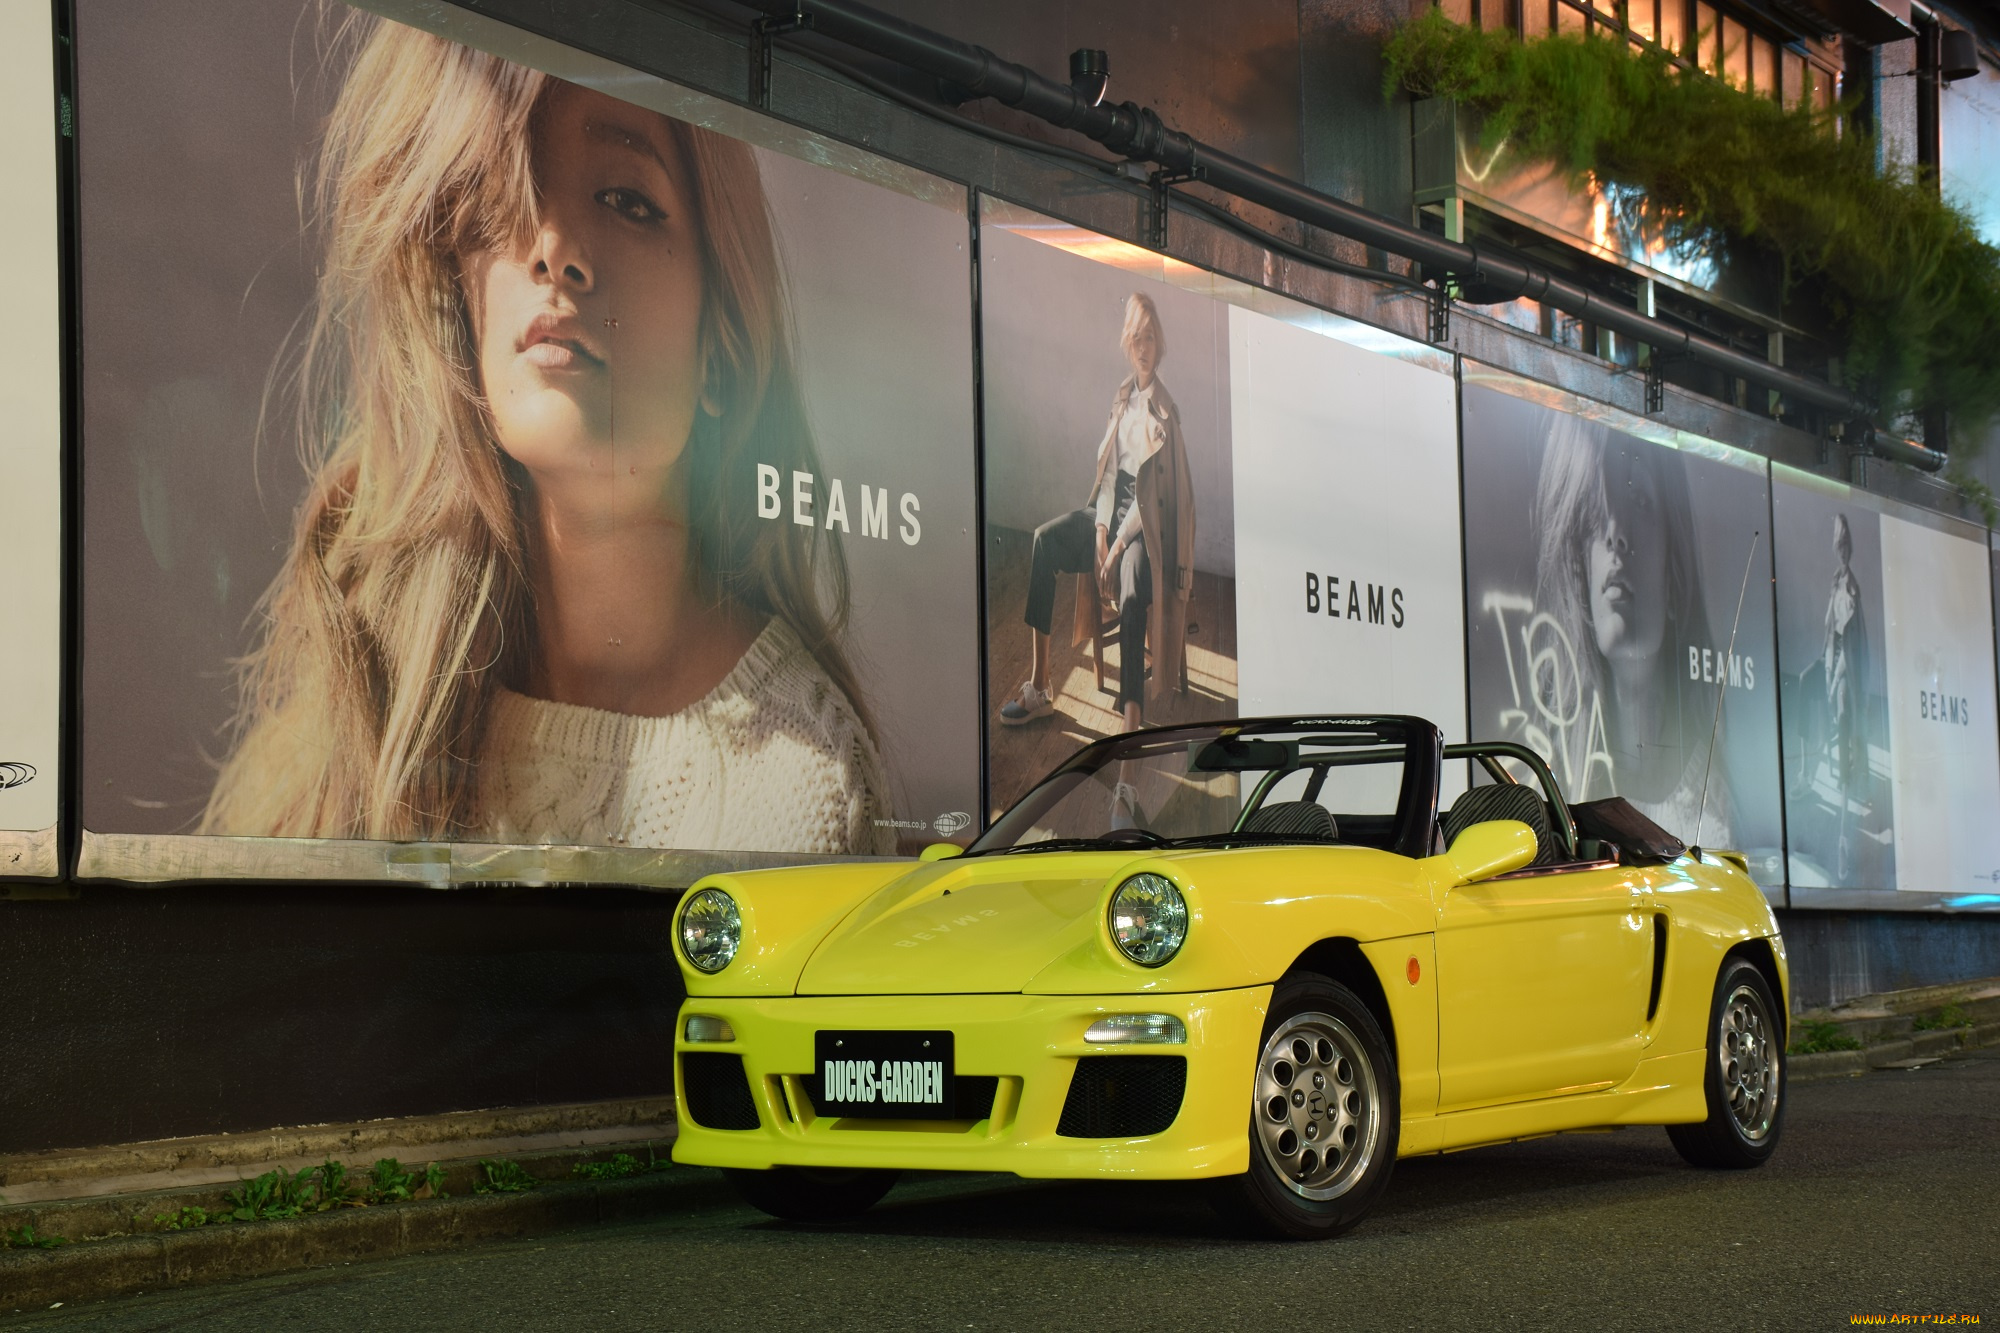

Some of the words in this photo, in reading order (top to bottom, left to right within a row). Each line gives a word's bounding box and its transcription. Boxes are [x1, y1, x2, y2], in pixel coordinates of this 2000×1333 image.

[757, 463, 921, 546] BEAMS
[1306, 571, 1404, 629] BEAMS
[1688, 645, 1755, 691] BEAMS
[1920, 690, 1969, 727] BEAMS
[873, 817, 927, 831] www.beams.co.jp
[824, 1059, 943, 1104] DUCKS-GARDEN
